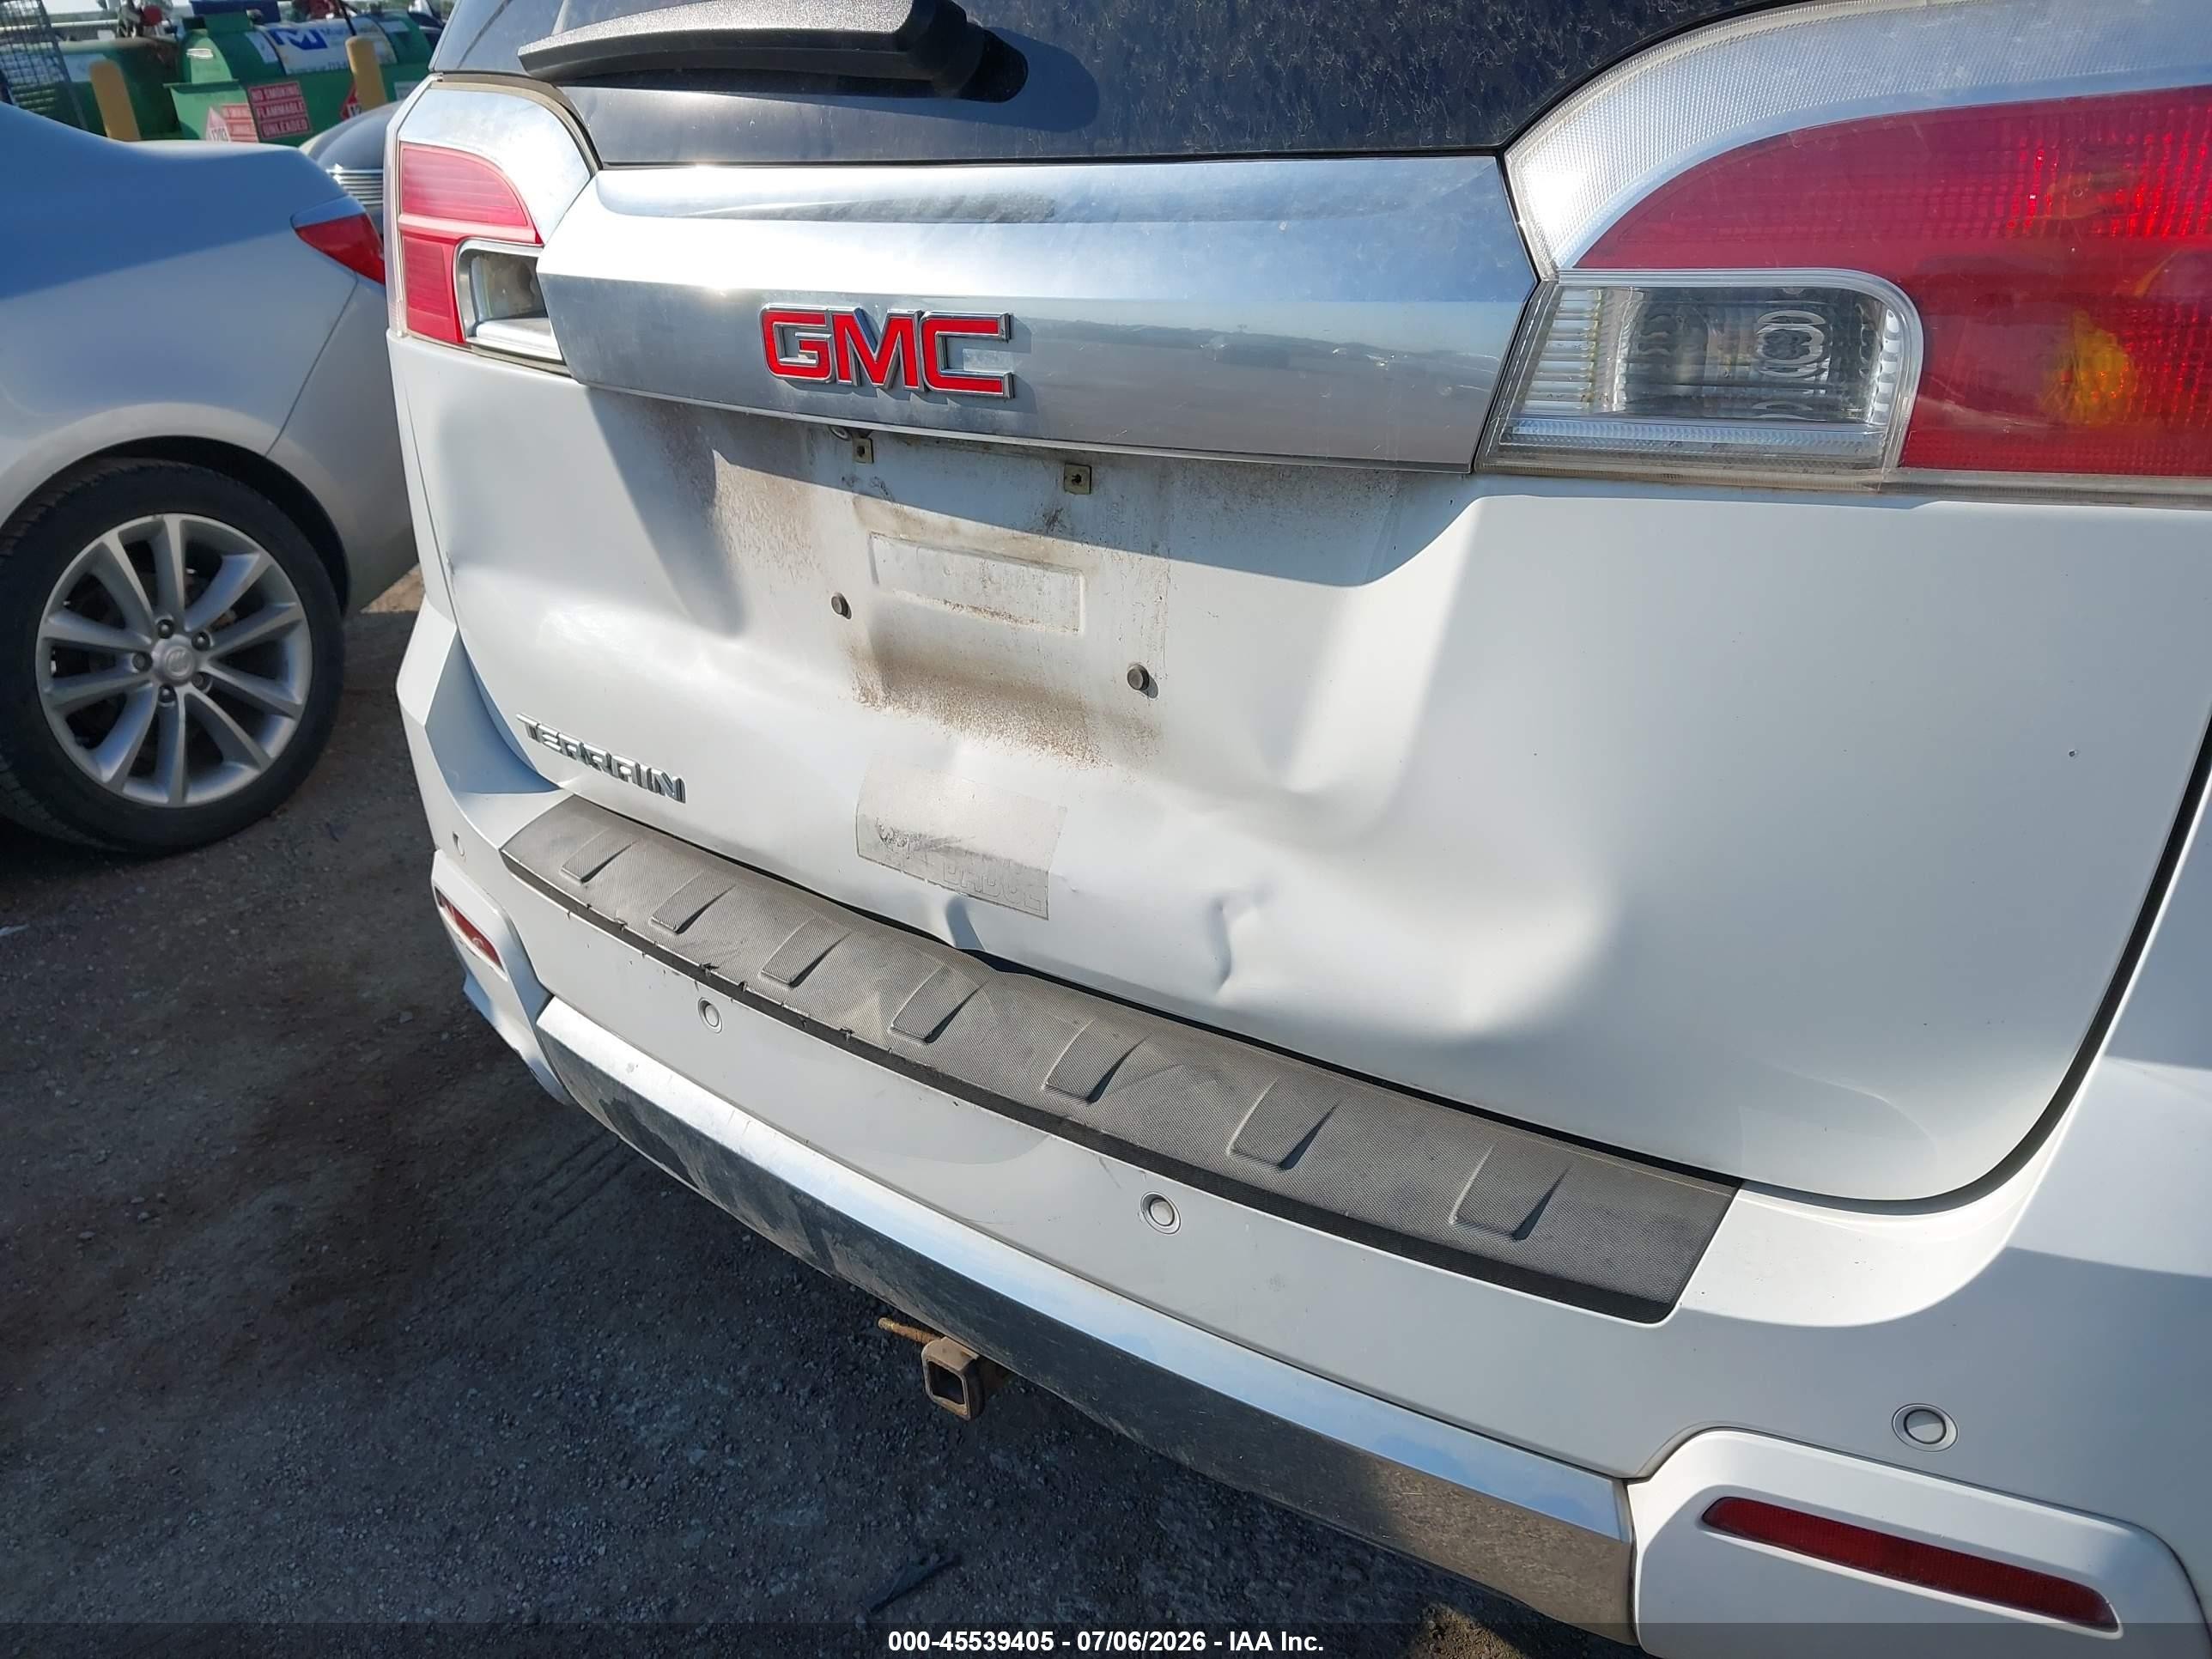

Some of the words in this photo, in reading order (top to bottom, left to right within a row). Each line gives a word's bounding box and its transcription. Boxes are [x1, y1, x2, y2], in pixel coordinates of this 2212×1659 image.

[257, 99, 305, 119] FLAMMABLE
[761, 302, 1015, 398] GMC
[516, 714, 686, 804] TERRAIN
